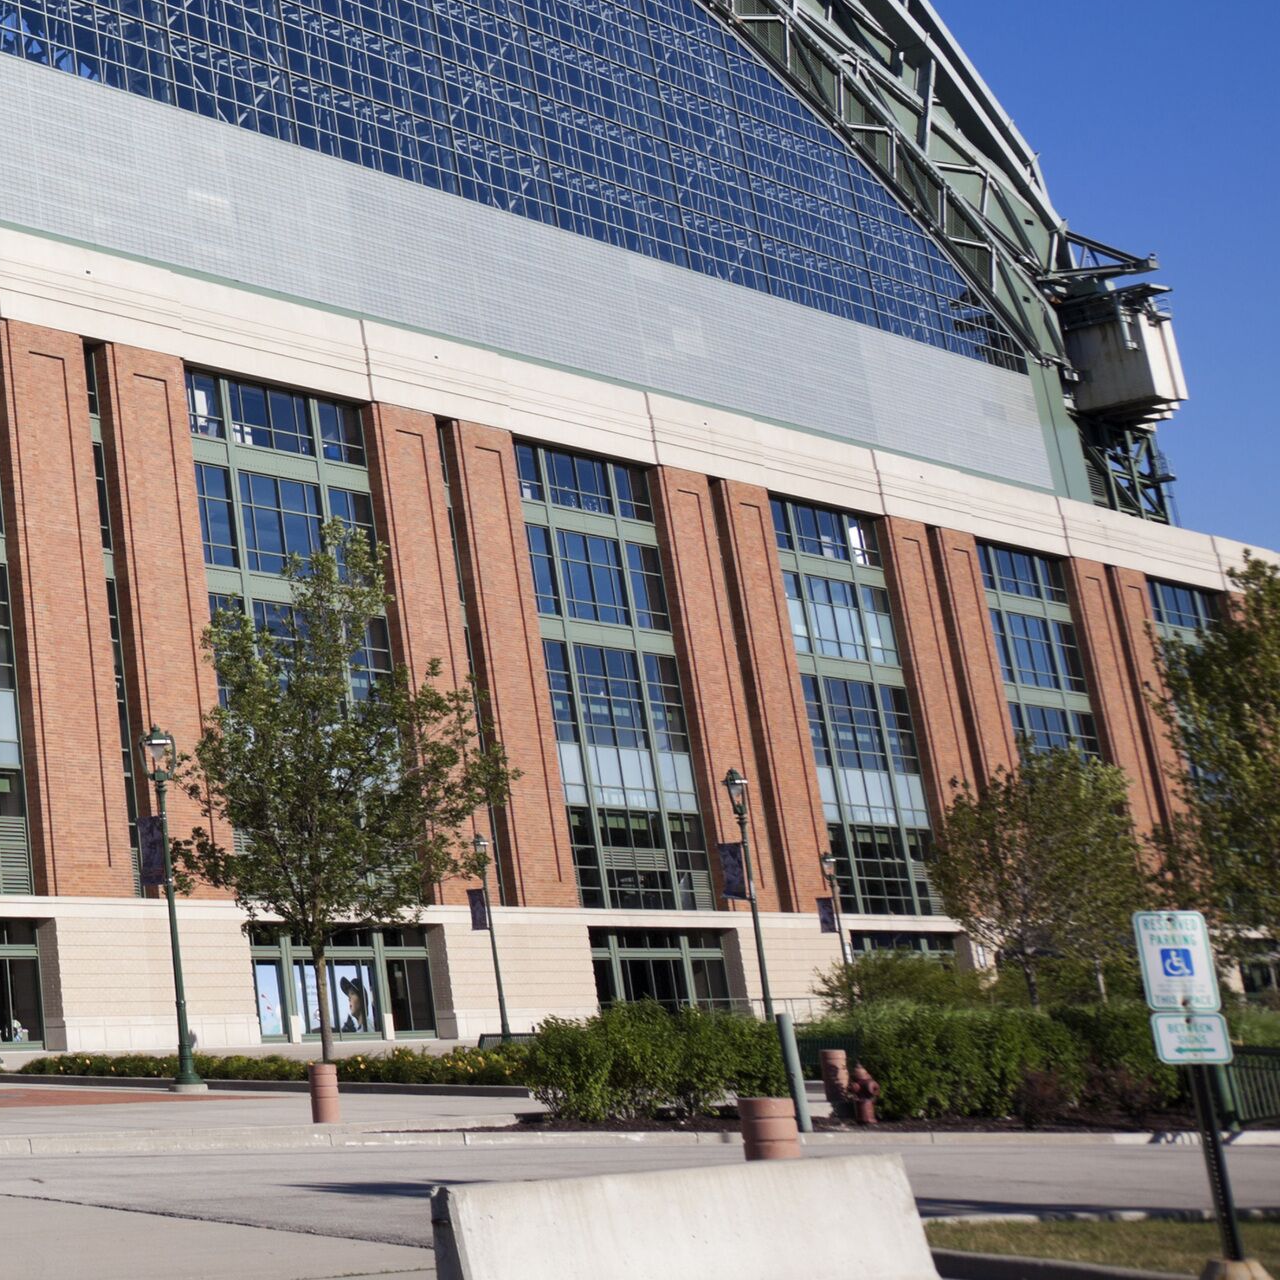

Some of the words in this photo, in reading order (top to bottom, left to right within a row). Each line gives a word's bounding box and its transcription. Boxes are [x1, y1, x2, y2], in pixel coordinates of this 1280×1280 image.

[1142, 919, 1198, 931] RESERVED
[1150, 934, 1197, 946] PARKING
[1167, 1023, 1214, 1034] BETWEEN
